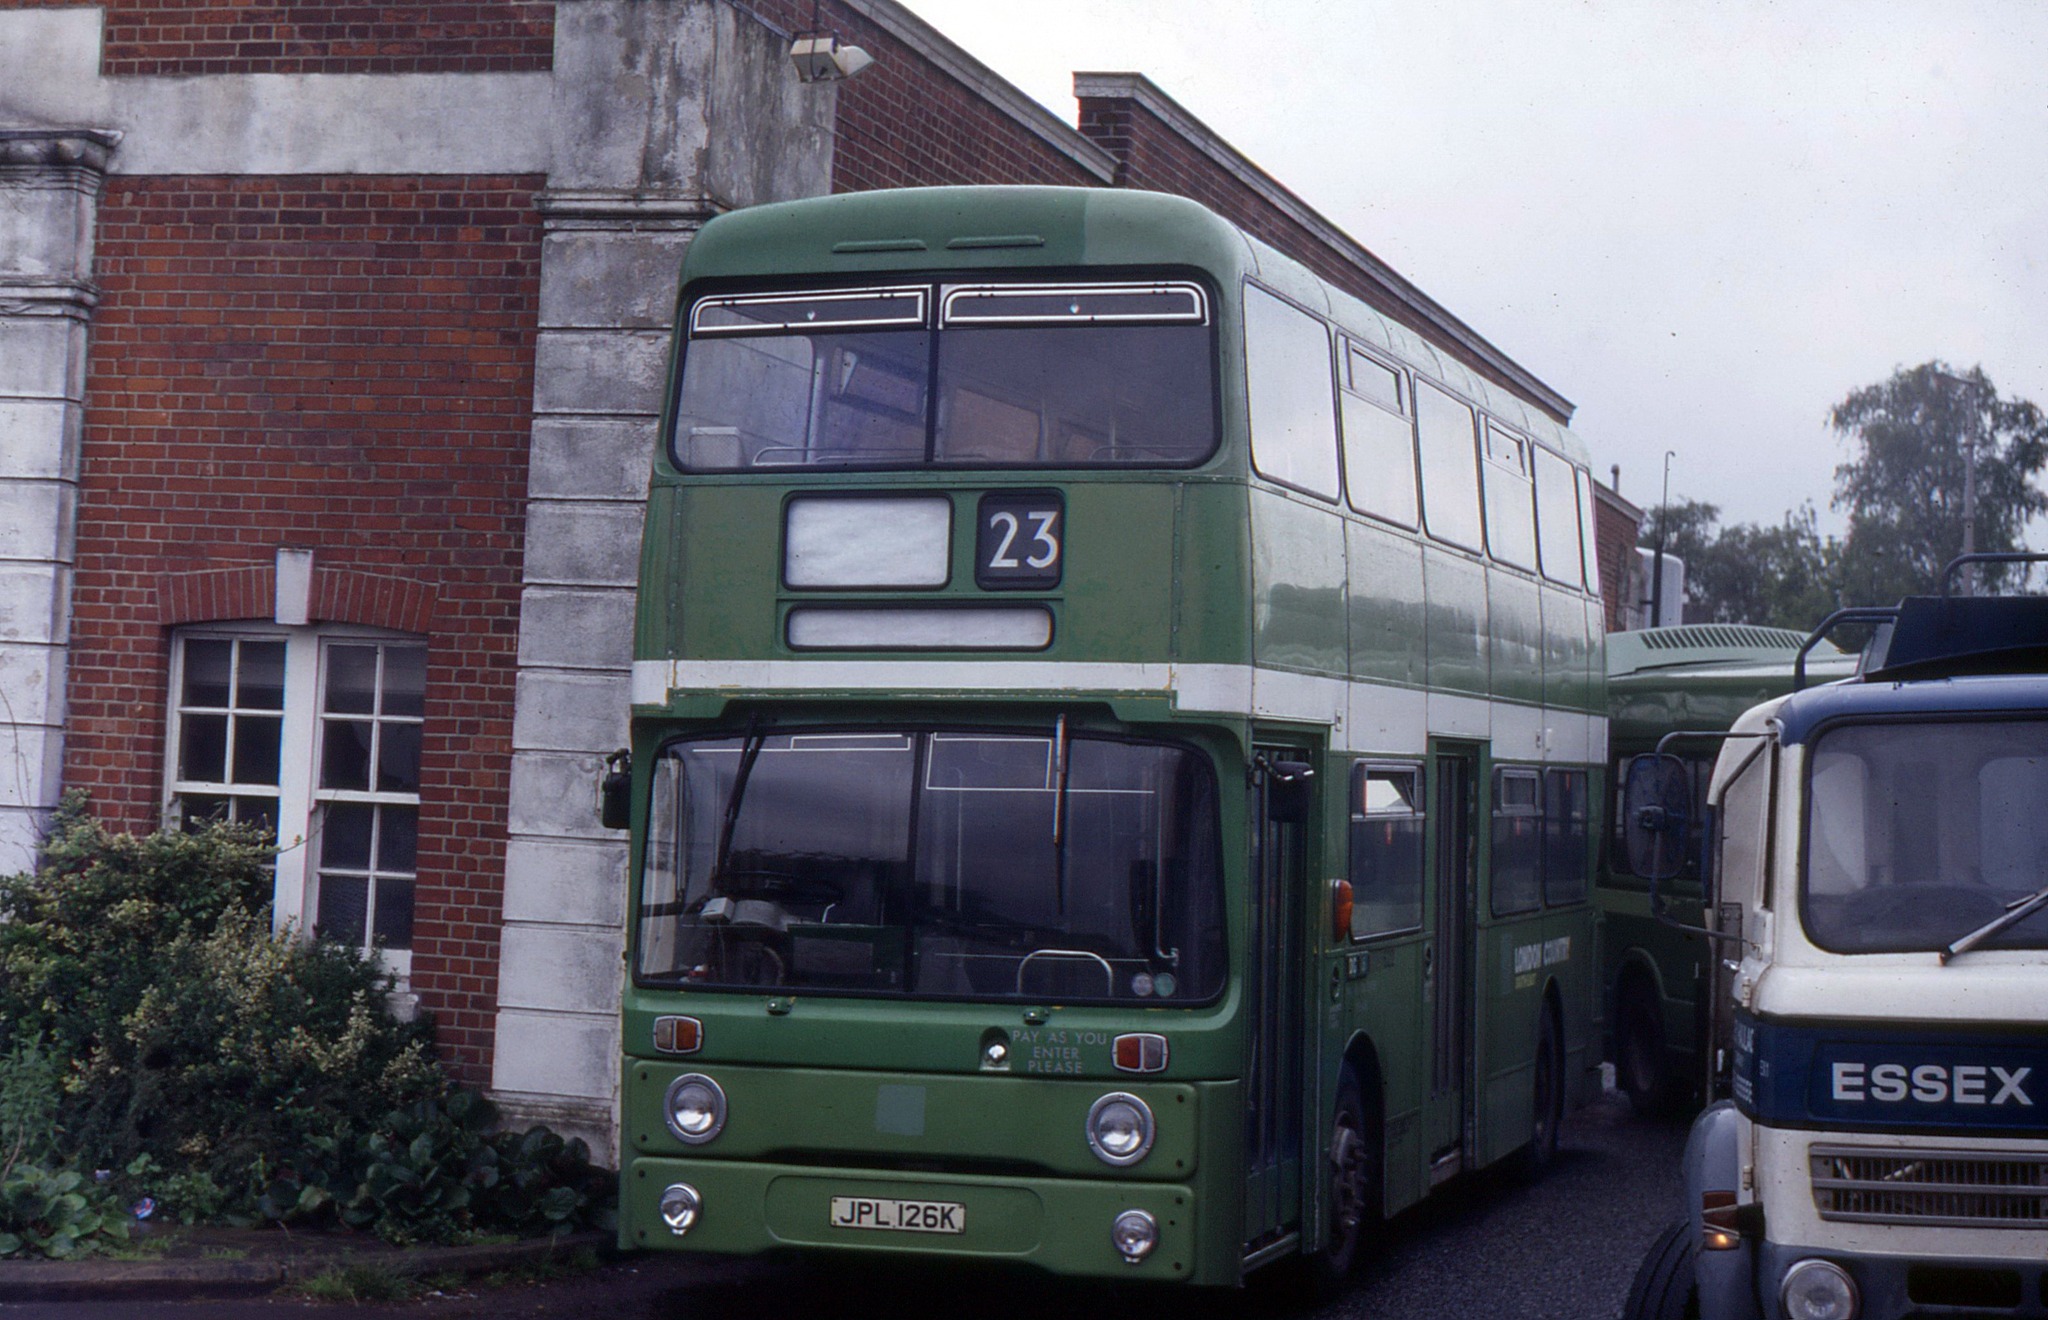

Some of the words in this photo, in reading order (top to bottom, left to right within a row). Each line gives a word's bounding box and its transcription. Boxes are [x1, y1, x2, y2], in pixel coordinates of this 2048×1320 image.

[989, 511, 1058, 568] 23
[1012, 1029, 1039, 1043] PAY
[1047, 1030, 1067, 1044] AS
[1075, 1031, 1107, 1045] YOU
[1033, 1046, 1080, 1060] ENTER
[1028, 1060, 1082, 1074] PLEASE
[1831, 1061, 2034, 1106] ESSEX
[839, 1200, 891, 1226] JPL
[897, 1203, 956, 1229] 126K
